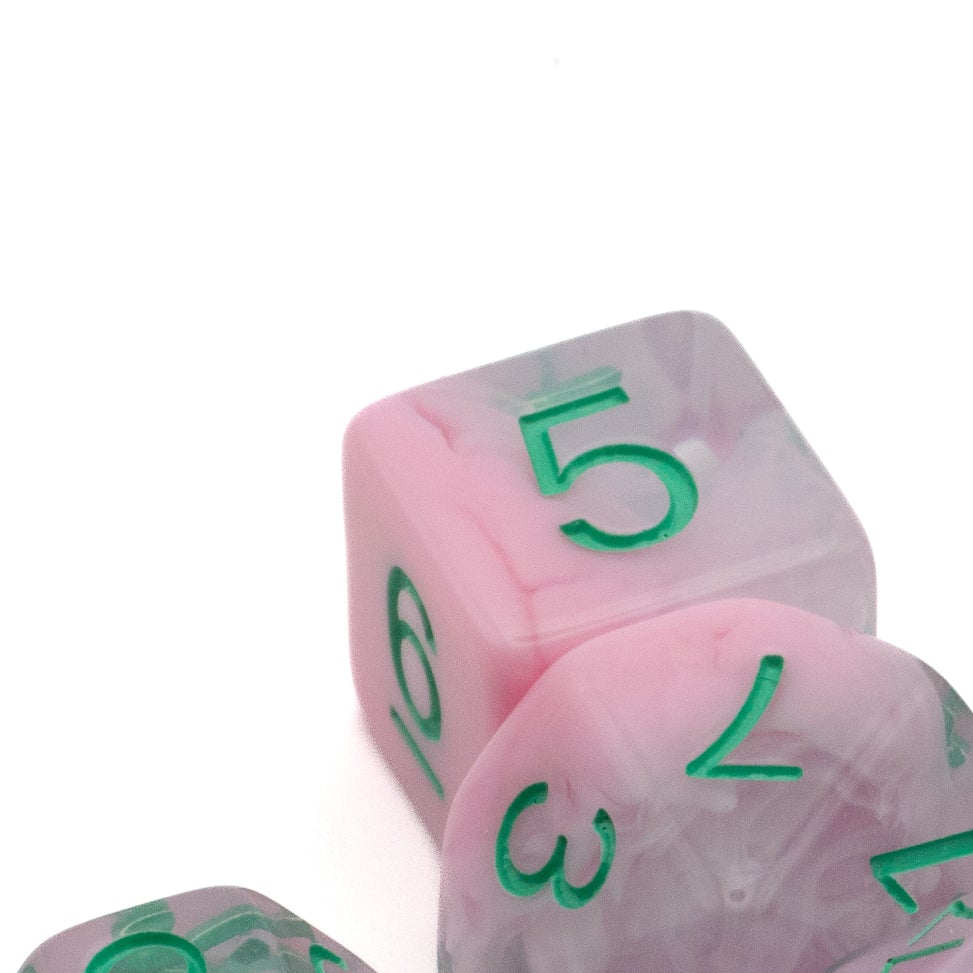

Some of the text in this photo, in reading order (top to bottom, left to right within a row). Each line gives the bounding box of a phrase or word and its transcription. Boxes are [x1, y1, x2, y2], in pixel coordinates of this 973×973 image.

[518, 386, 700, 553] 5
[685, 655, 804, 781] 7
[494, 781, 617, 910] 3
